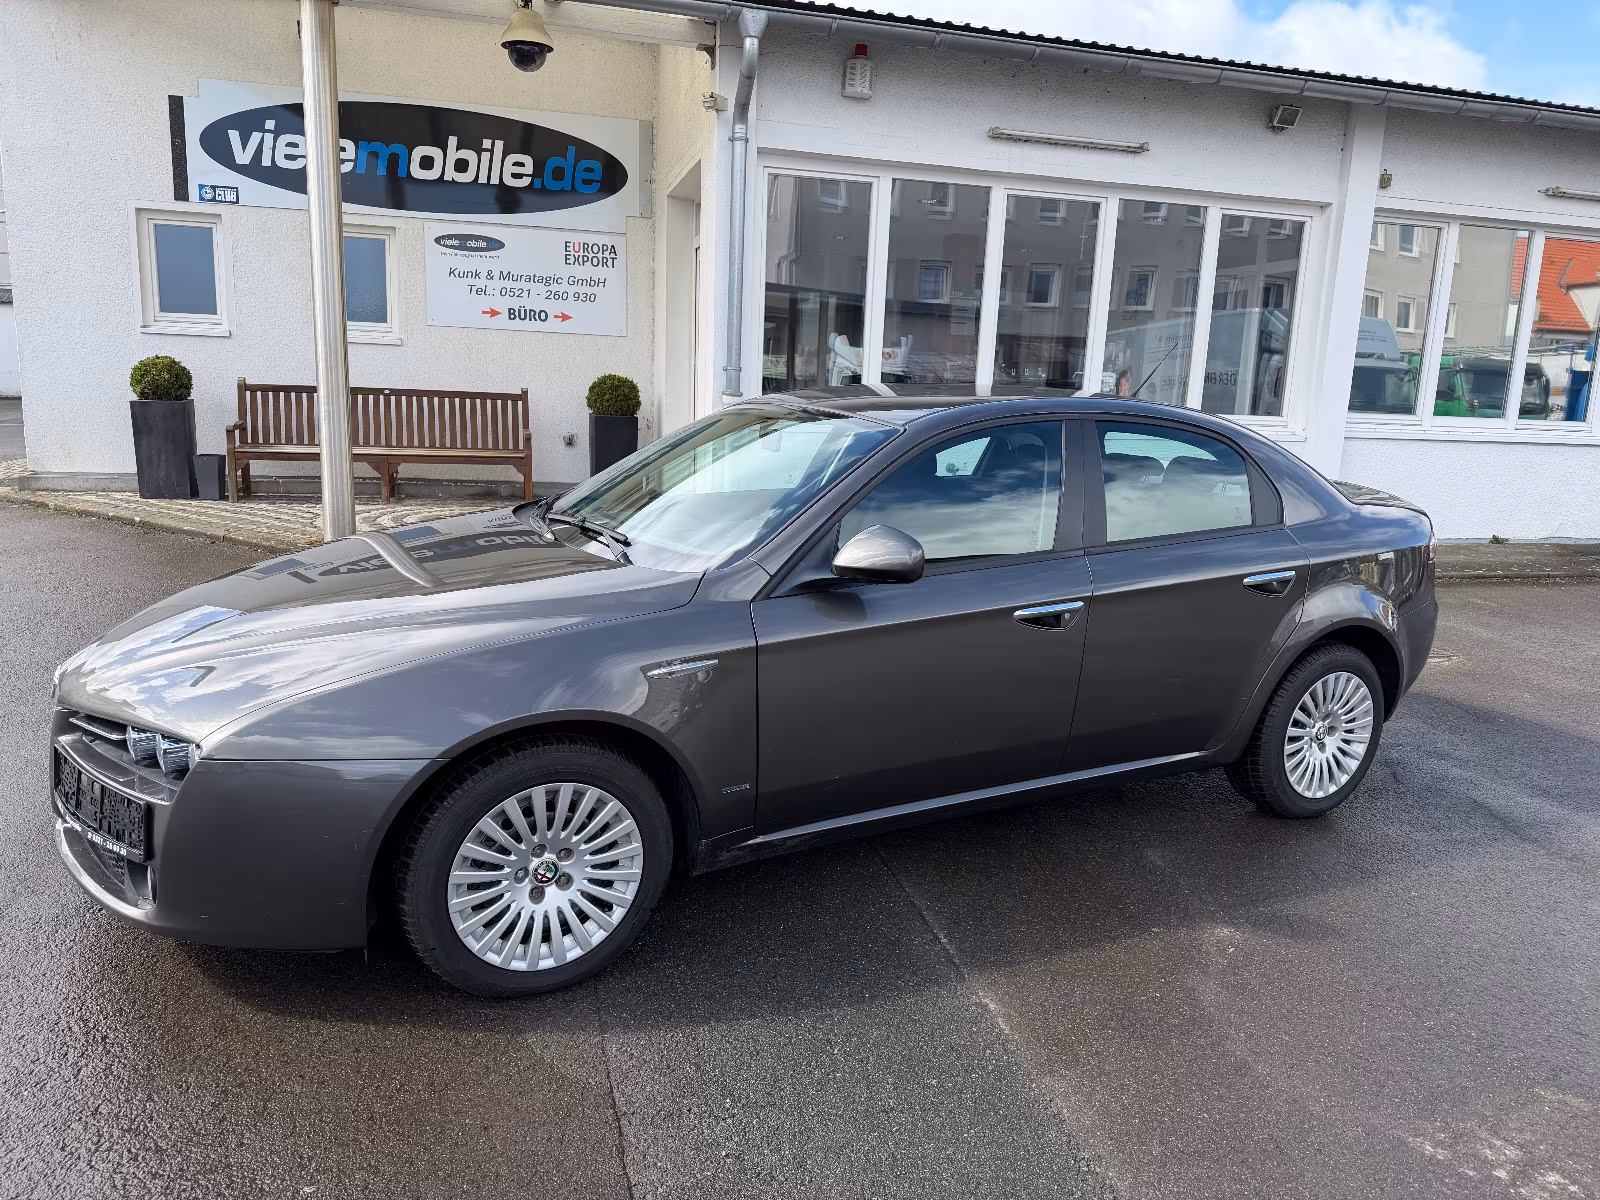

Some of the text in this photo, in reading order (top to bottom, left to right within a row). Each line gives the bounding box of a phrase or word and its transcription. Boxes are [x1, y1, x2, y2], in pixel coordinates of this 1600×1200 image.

[227, 119, 603, 193] vieemobile.de
[564, 240, 618, 257] EUROPA
[564, 253, 618, 269] EXPORT
[448, 267, 607, 288] Kunk & Muratagic GmbH
[467, 284, 496, 297] Tel.:
[499, 286, 531, 299] 0521
[544, 289, 569, 301] 260
[573, 291, 597, 303] 930
[507, 306, 549, 323] BÜRO
